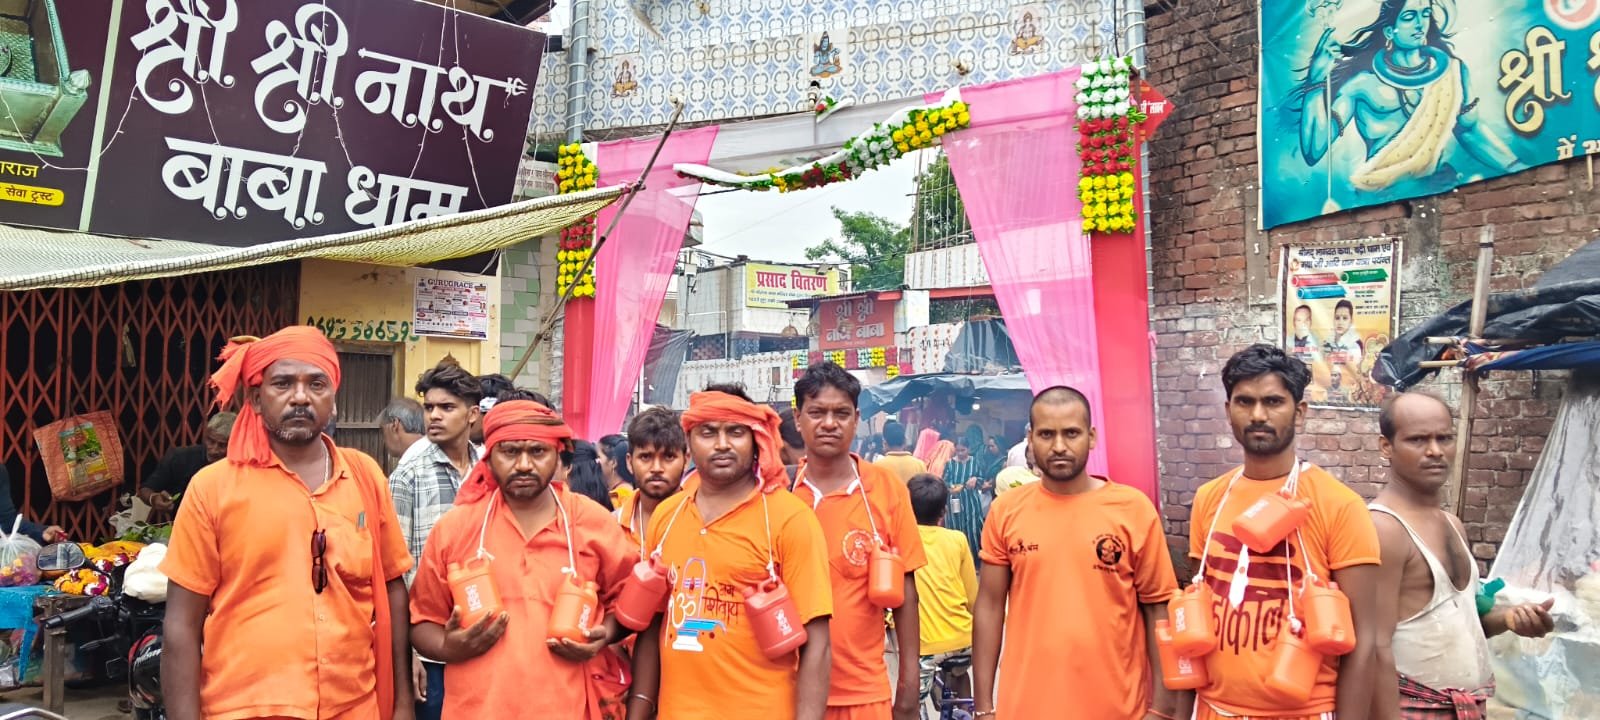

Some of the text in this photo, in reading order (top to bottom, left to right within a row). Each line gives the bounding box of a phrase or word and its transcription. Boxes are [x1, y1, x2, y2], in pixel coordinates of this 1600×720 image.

[130, 0, 527, 142] श्री श्री नाथ
[1498, 25, 1572, 133] श्री
[6, 185, 27, 199] सेवा
[162, 137, 469, 230] बाबा धाम
[756, 270, 827, 291] प्रसाद वितरण
[856, 322, 884, 338] बाबा
